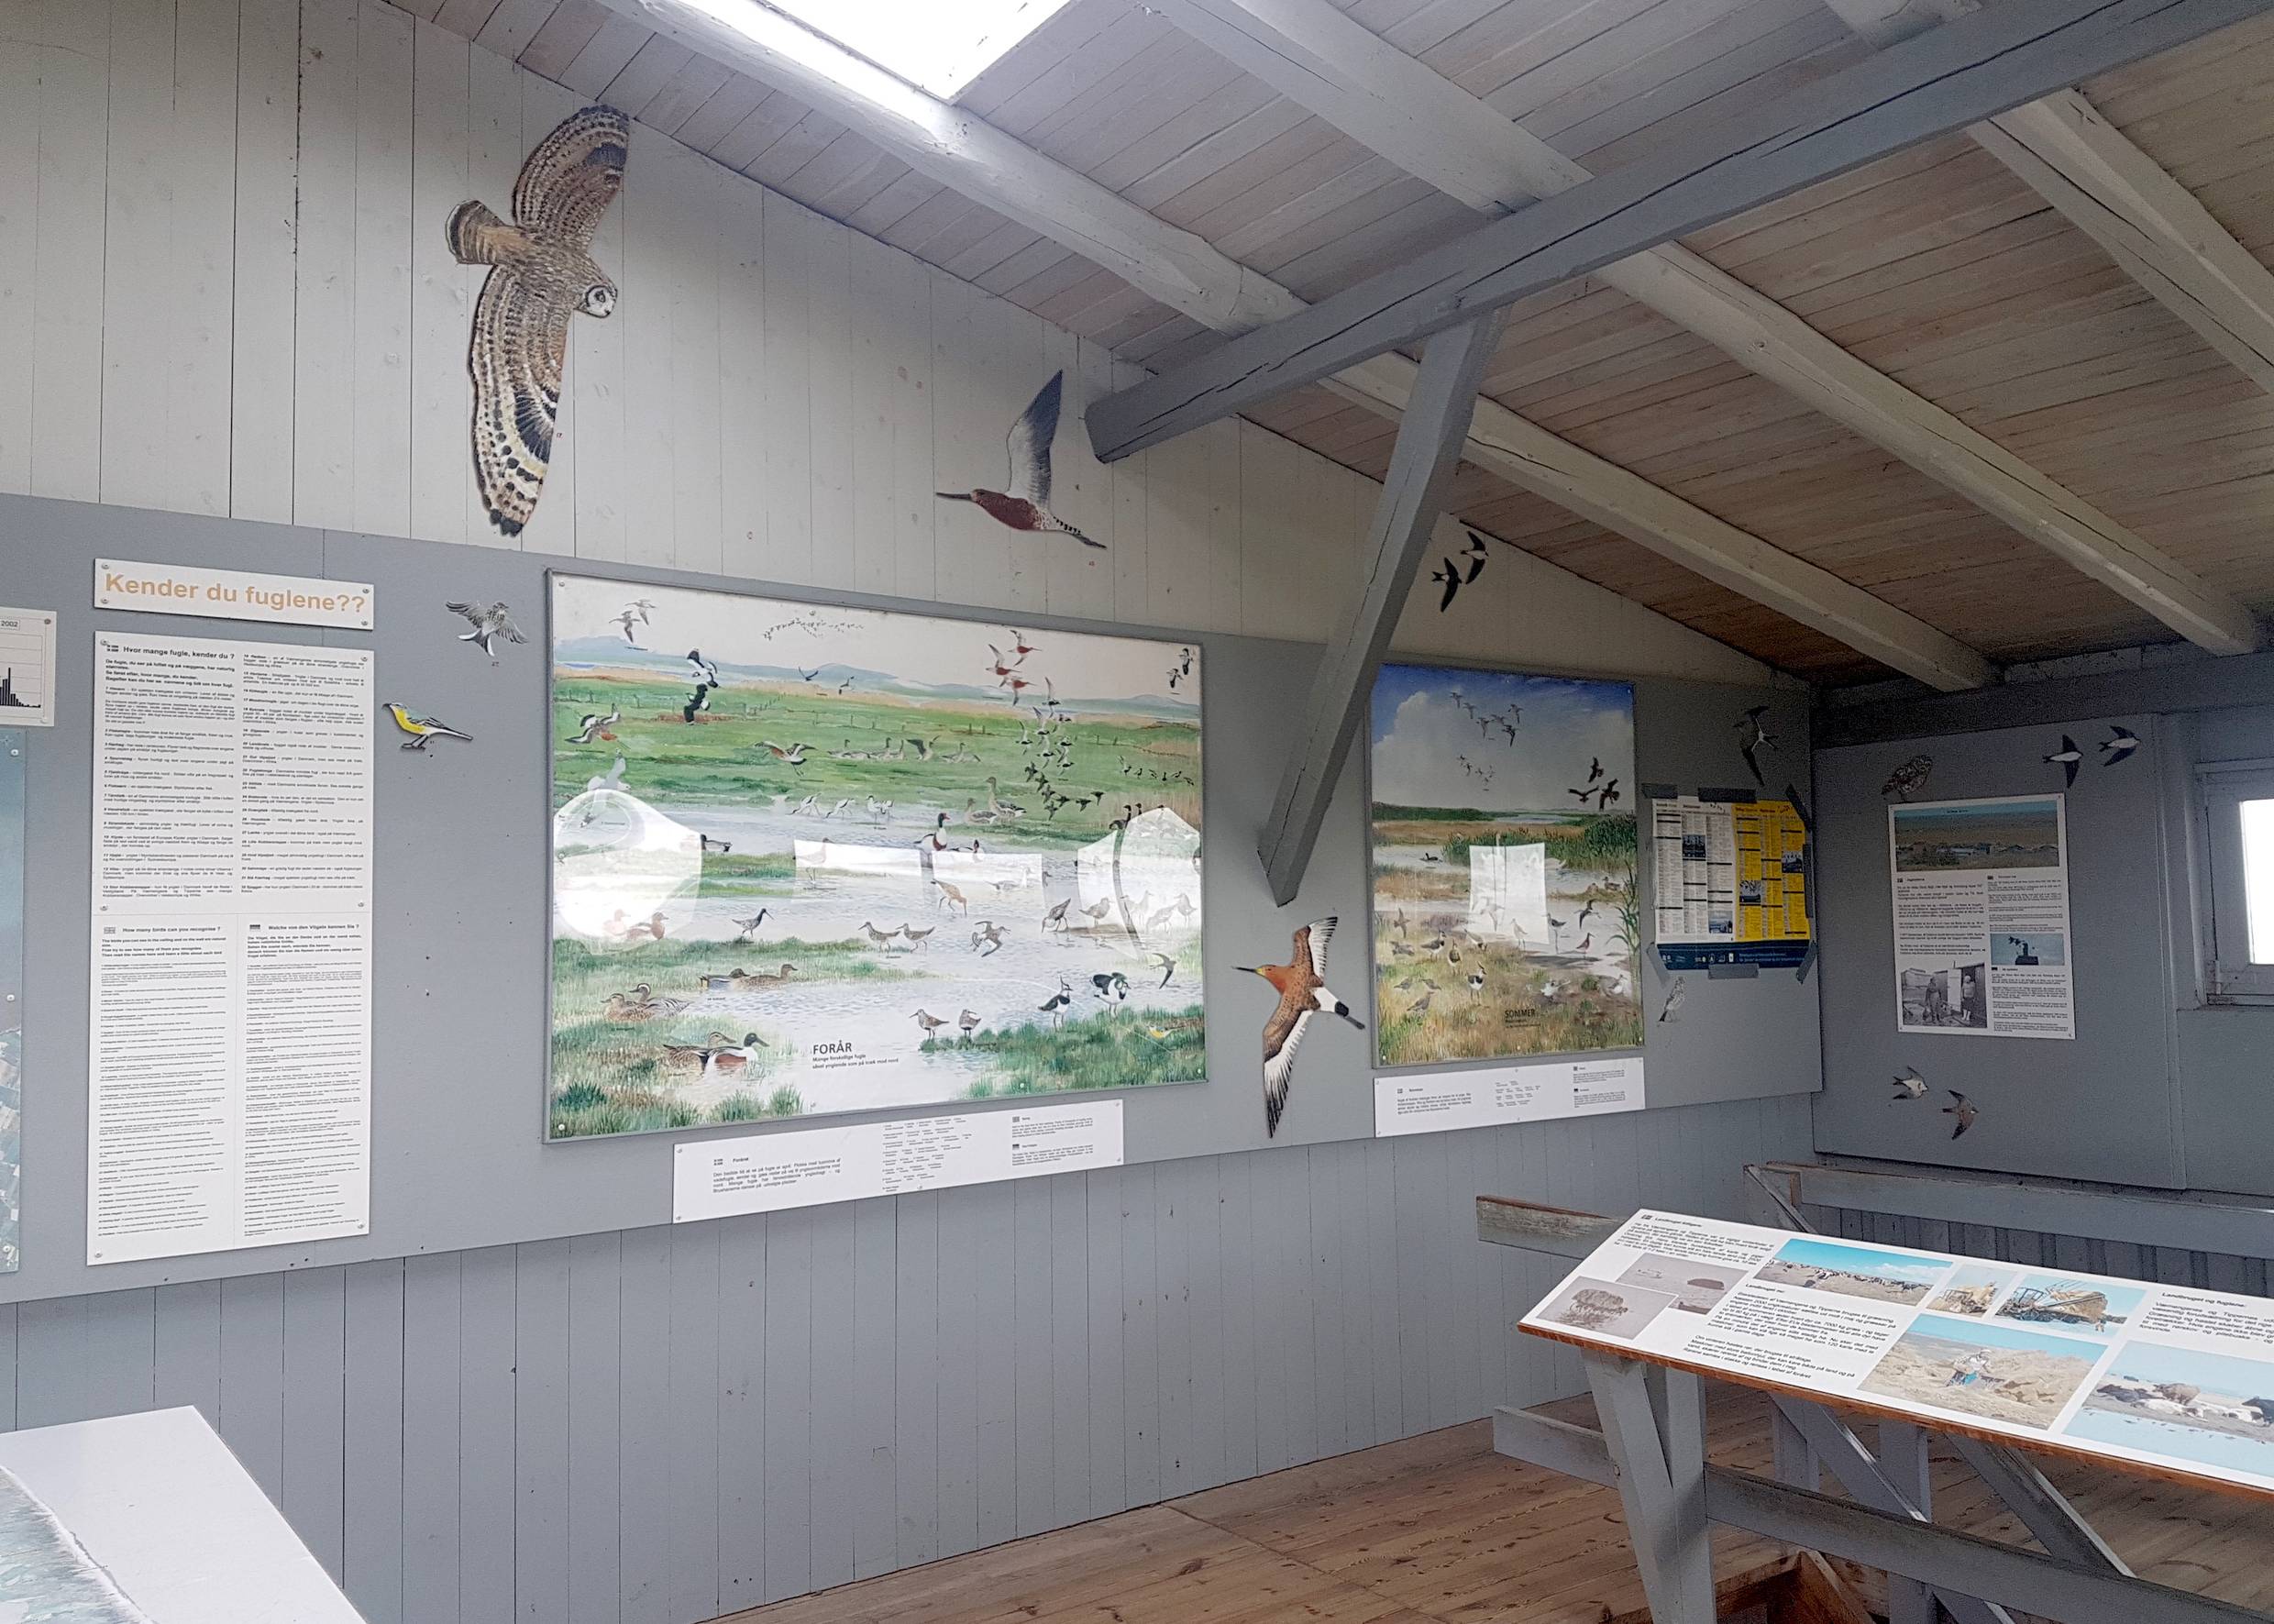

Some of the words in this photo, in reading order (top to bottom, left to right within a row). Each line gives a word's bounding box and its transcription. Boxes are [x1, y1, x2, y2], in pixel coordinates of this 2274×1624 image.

[105, 573, 199, 599] Kender
[206, 583, 237, 602] du
[246, 586, 365, 613] fuglene??
[170, 649, 190, 657] fugle,
[1505, 1009, 1535, 1018] SOMMER
[813, 1040, 852, 1055] FORÅR
